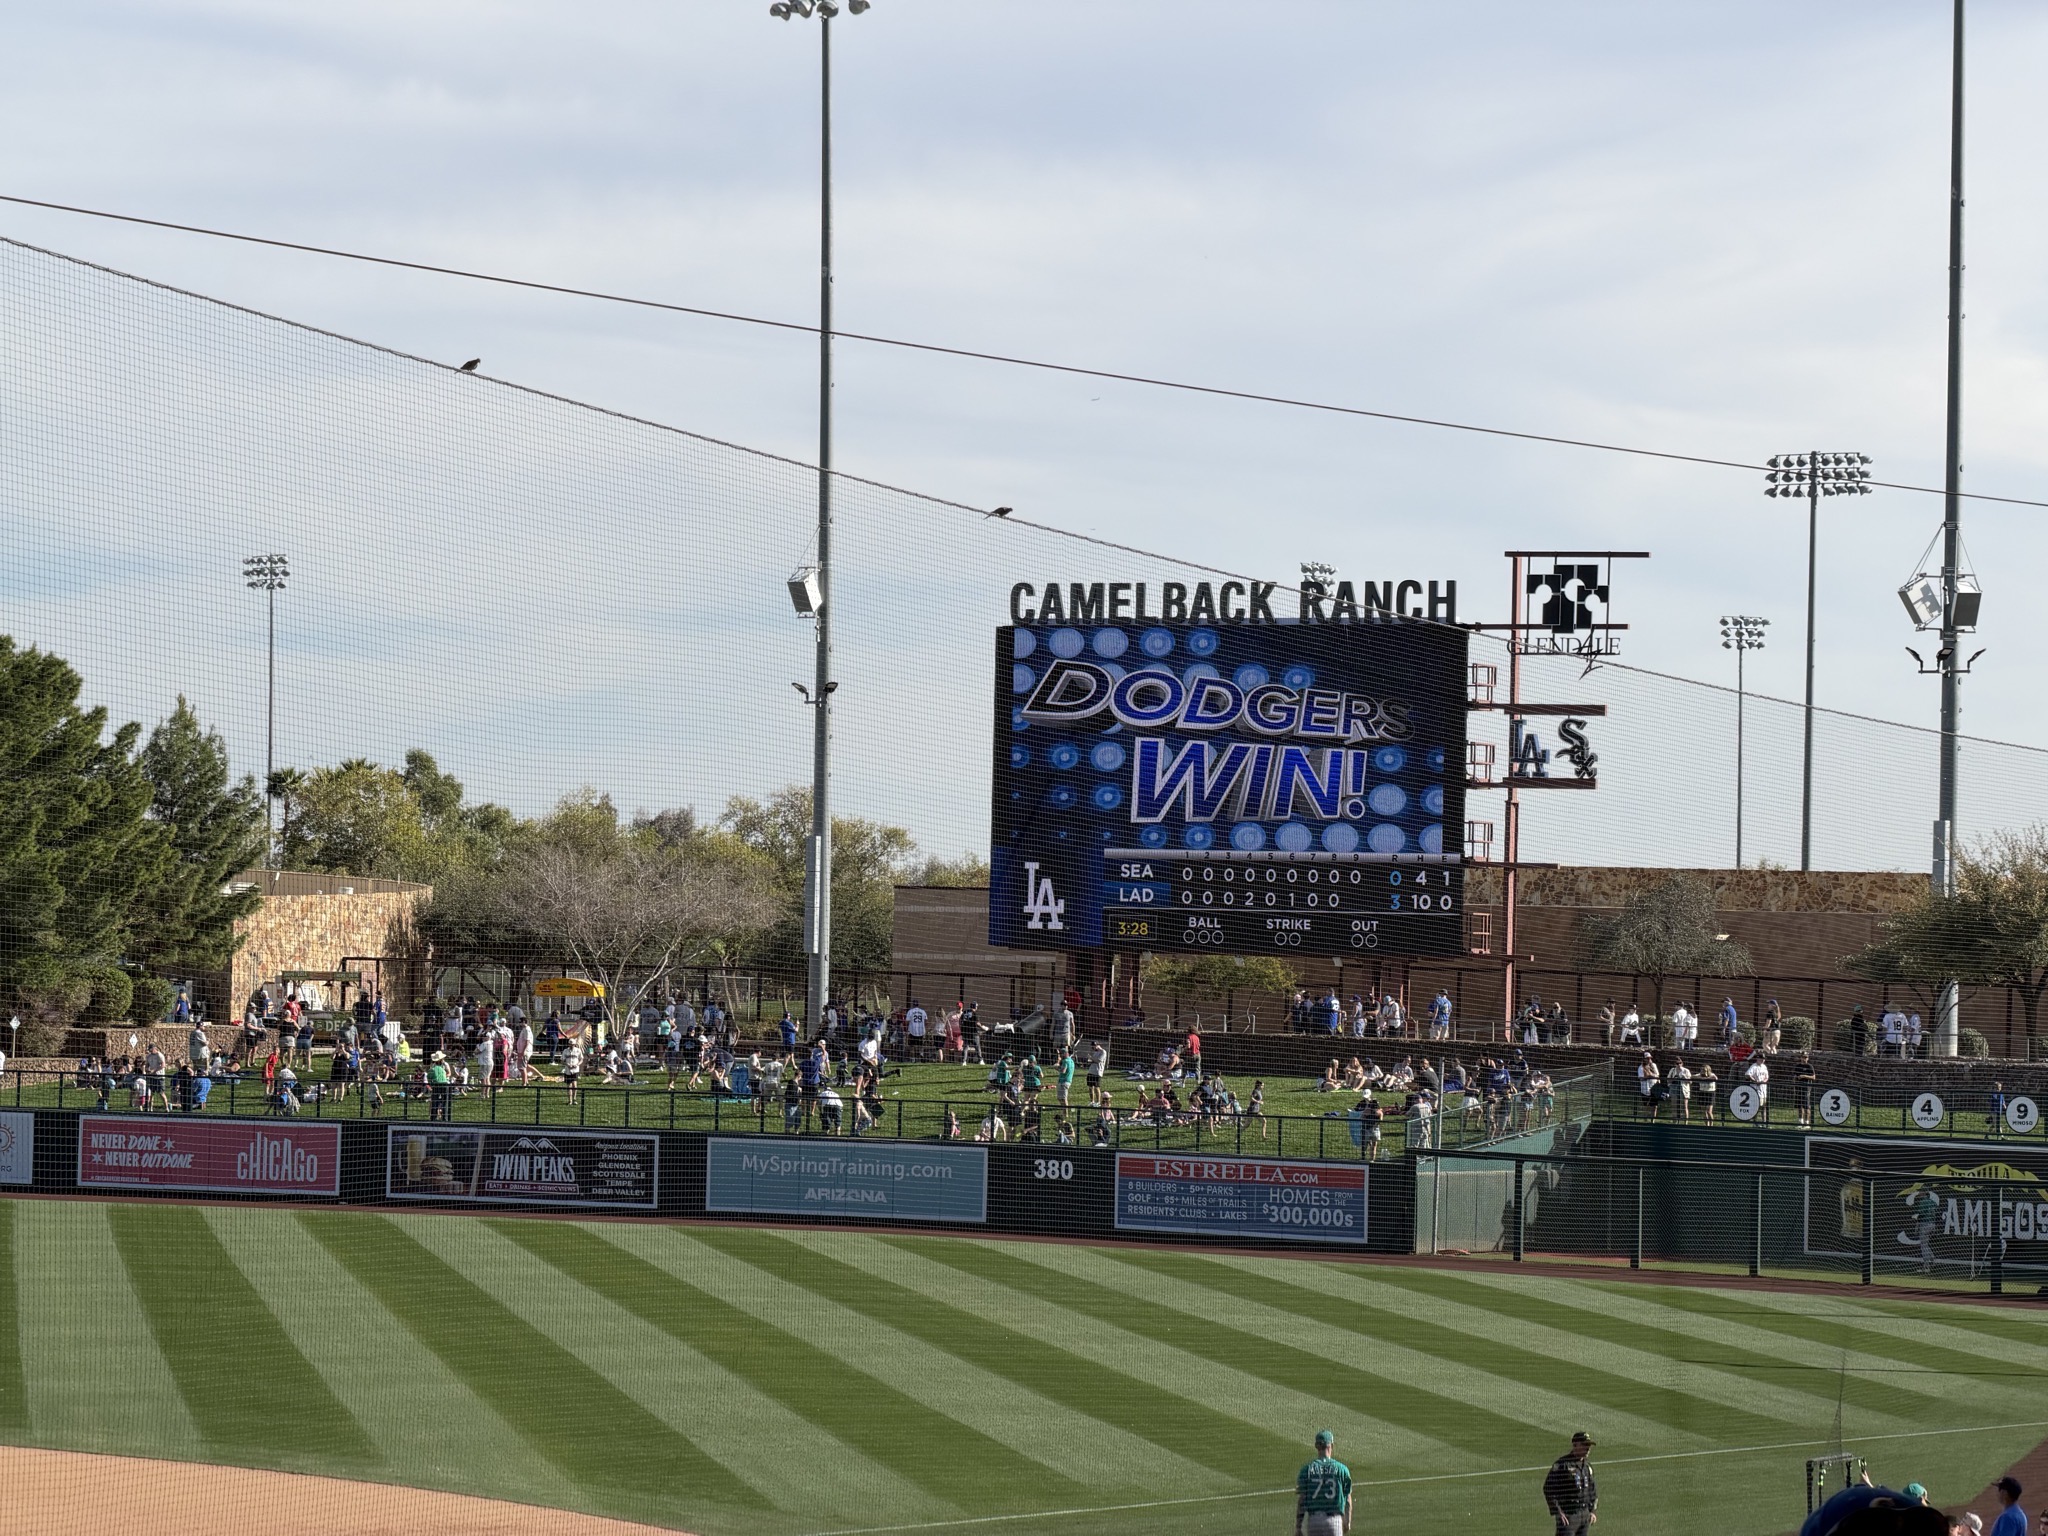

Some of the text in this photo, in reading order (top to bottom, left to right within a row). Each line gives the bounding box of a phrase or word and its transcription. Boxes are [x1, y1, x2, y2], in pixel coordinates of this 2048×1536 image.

[1010, 579, 1457, 625] CAMELBACK RANCH
[1021, 659, 1416, 746] DODGERS
[1130, 737, 1367, 824] WIN!
[1120, 863, 1449, 886] SEA 0 0 0 0 0 0 0 0 0 0 4 1
[1024, 862, 1064, 929] LA
[1119, 887, 1452, 910] LAD 0 0 0 2 0 1 0 0 3 10 0
[1118, 922, 1149, 935] 3:28
[1188, 917, 1221, 928] BALL
[1266, 919, 1311, 930] STRIKE
[1351, 920, 1379, 932] OUT
[1740, 1092, 1750, 1107] 2
[1830, 1095, 1841, 1111] 3
[1920, 1100, 1933, 1115] 4
[2016, 1103, 2028, 1119] 9
[91, 1133, 161, 1150] NEVER DONE
[105, 1151, 194, 1169] NEVER OUTDONE
[602, 1153, 637, 1161] PHOENIX
[492, 1154, 575, 1182] TWIN PEAKS
[598, 1162, 641, 1170] GLENDALE
[742, 1154, 953, 1180] MySpringTraining.com
[1033, 1159, 1074, 1180] 380
[593, 1170, 645, 1179] SCOTTSDALE
[605, 1179, 633, 1187] TEMPE
[1128, 1181, 1134, 1190] 8
[1135, 1182, 1177, 1193] BUILDERS
[1206, 1185, 1234, 1196] PARKS
[592, 1187, 645, 1196] DEER VALLEY
[804, 1187, 887, 1204] ARIZONA
[1269, 1187, 1330, 1206] HOMES
[1334, 1191, 1353, 1199] FROM
[1127, 1193, 1152, 1203] GOLF
[1181, 1196, 1207, 1207] MILES
[1218, 1198, 1247, 1208] TRAILS
[1179, 1208, 1207, 1218] CLUBS
[1220, 1211, 1248, 1220] LAKES
[1262, 1203, 1354, 1227] $300,000s
[1311, 1478, 1337, 1499] 73
